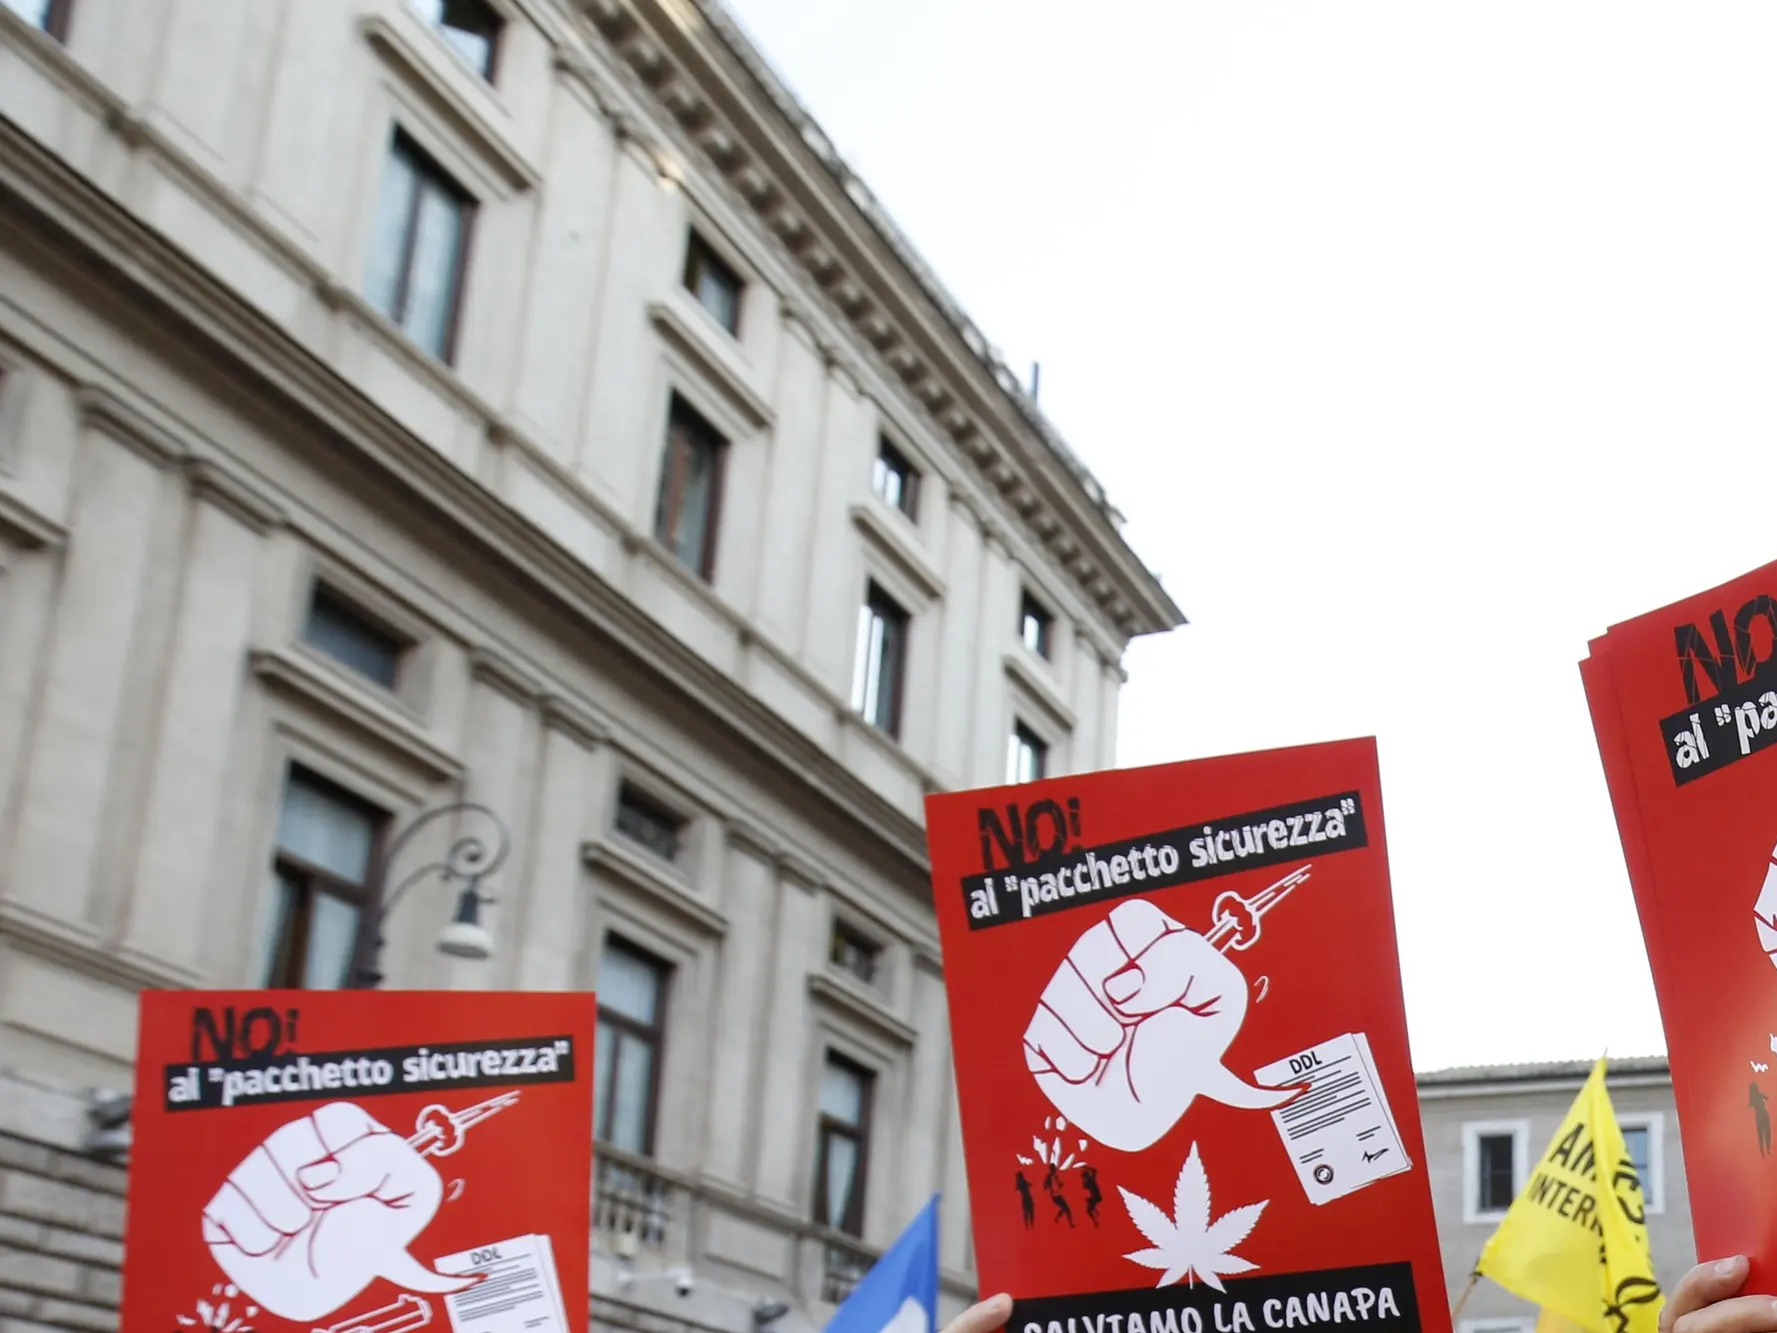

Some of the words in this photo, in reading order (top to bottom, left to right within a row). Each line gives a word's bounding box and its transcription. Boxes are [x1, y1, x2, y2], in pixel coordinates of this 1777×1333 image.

[1673, 712, 1710, 769] al
[970, 877, 999, 919] al
[1004, 843, 1180, 918] "pacchetto
[1189, 797, 1356, 868] sicurezza"
[168, 1067, 200, 1102] al
[208, 1056, 393, 1107] "pacchetto
[402, 1040, 569, 1083] sicurezza"
[1288, 1050, 1323, 1075] DDL
[1213, 1301, 1256, 1333] LA
[1262, 1287, 1401, 1329] CANAPA
